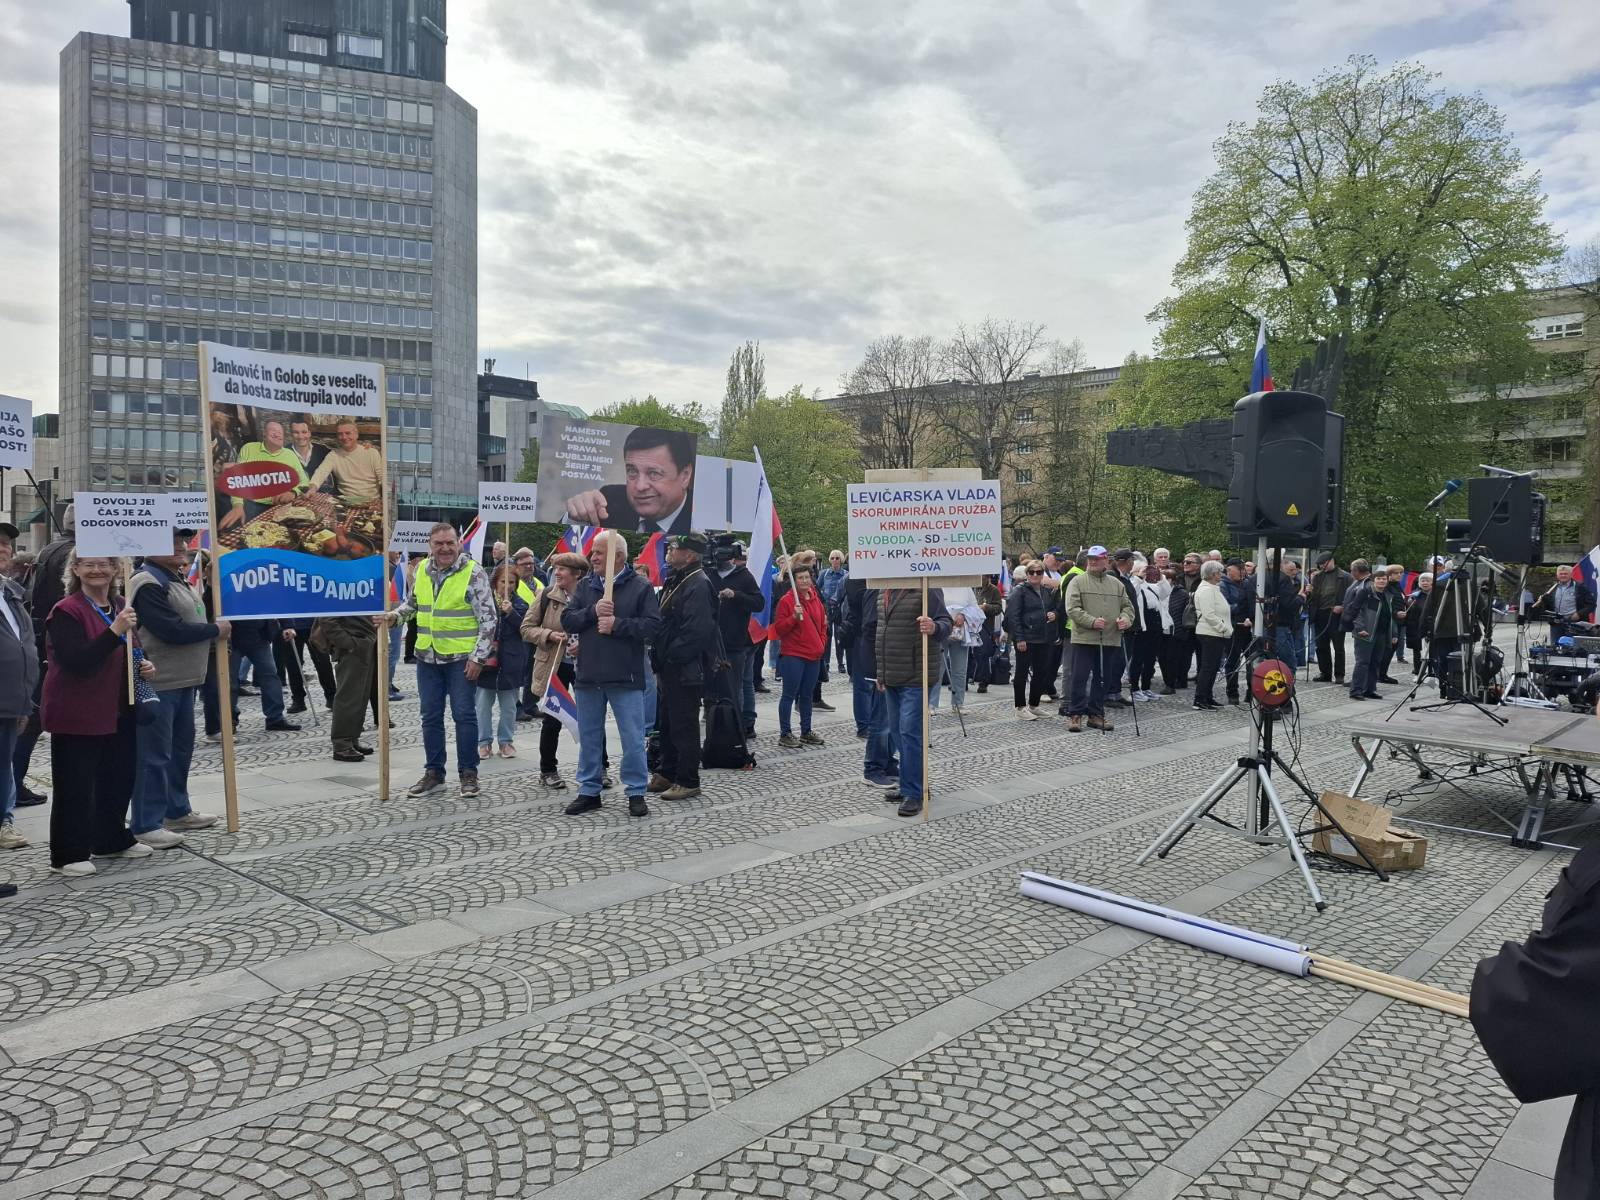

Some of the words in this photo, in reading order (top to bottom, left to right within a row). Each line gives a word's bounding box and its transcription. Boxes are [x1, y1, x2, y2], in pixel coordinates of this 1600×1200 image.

[212, 357, 259, 380] Janković
[261, 365, 272, 381] in
[275, 367, 309, 386] Golob
[312, 374, 326, 386] se
[328, 374, 377, 393] veselita,
[225, 377, 239, 394] da
[241, 379, 271, 399] bosta
[274, 386, 332, 407] zastrupila
[335, 391, 366, 407] vodo!
[565, 425, 608, 436] NAMESTO
[560, 433, 611, 446] VLADAVINE
[567, 444, 597, 453] PRAVA
[555, 451, 613, 464] LJUBLJANSKI
[565, 460, 590, 470] ŠERIF
[591, 464, 602, 472] JE
[226, 471, 291, 490] SRAMOTA!
[93, 497, 137, 506] DOVOLJ
[140, 498, 155, 506] JE!
[850, 488, 943, 504] LEVIČARSKA
[947, 488, 997, 501] VLADA
[97, 507, 119, 516] ČAS
[122, 508, 134, 516] JE
[138, 508, 152, 516] ZA
[948, 503, 996, 515] DRUŽBA
[81, 519, 168, 528] ODGOVORNOST!
[879, 520, 957, 531] KRIMINALCEV
[961, 520, 969, 529] V
[857, 535, 915, 545] SVOBODA
[924, 534, 940, 543] SD
[950, 533, 992, 543] LEVICA
[854, 550, 877, 560] RTV
[887, 549, 911, 559] KPK
[910, 562, 941, 572] SOVA
[230, 563, 280, 593] VODE
[283, 568, 307, 592] NE
[311, 575, 375, 600] DAMO!
